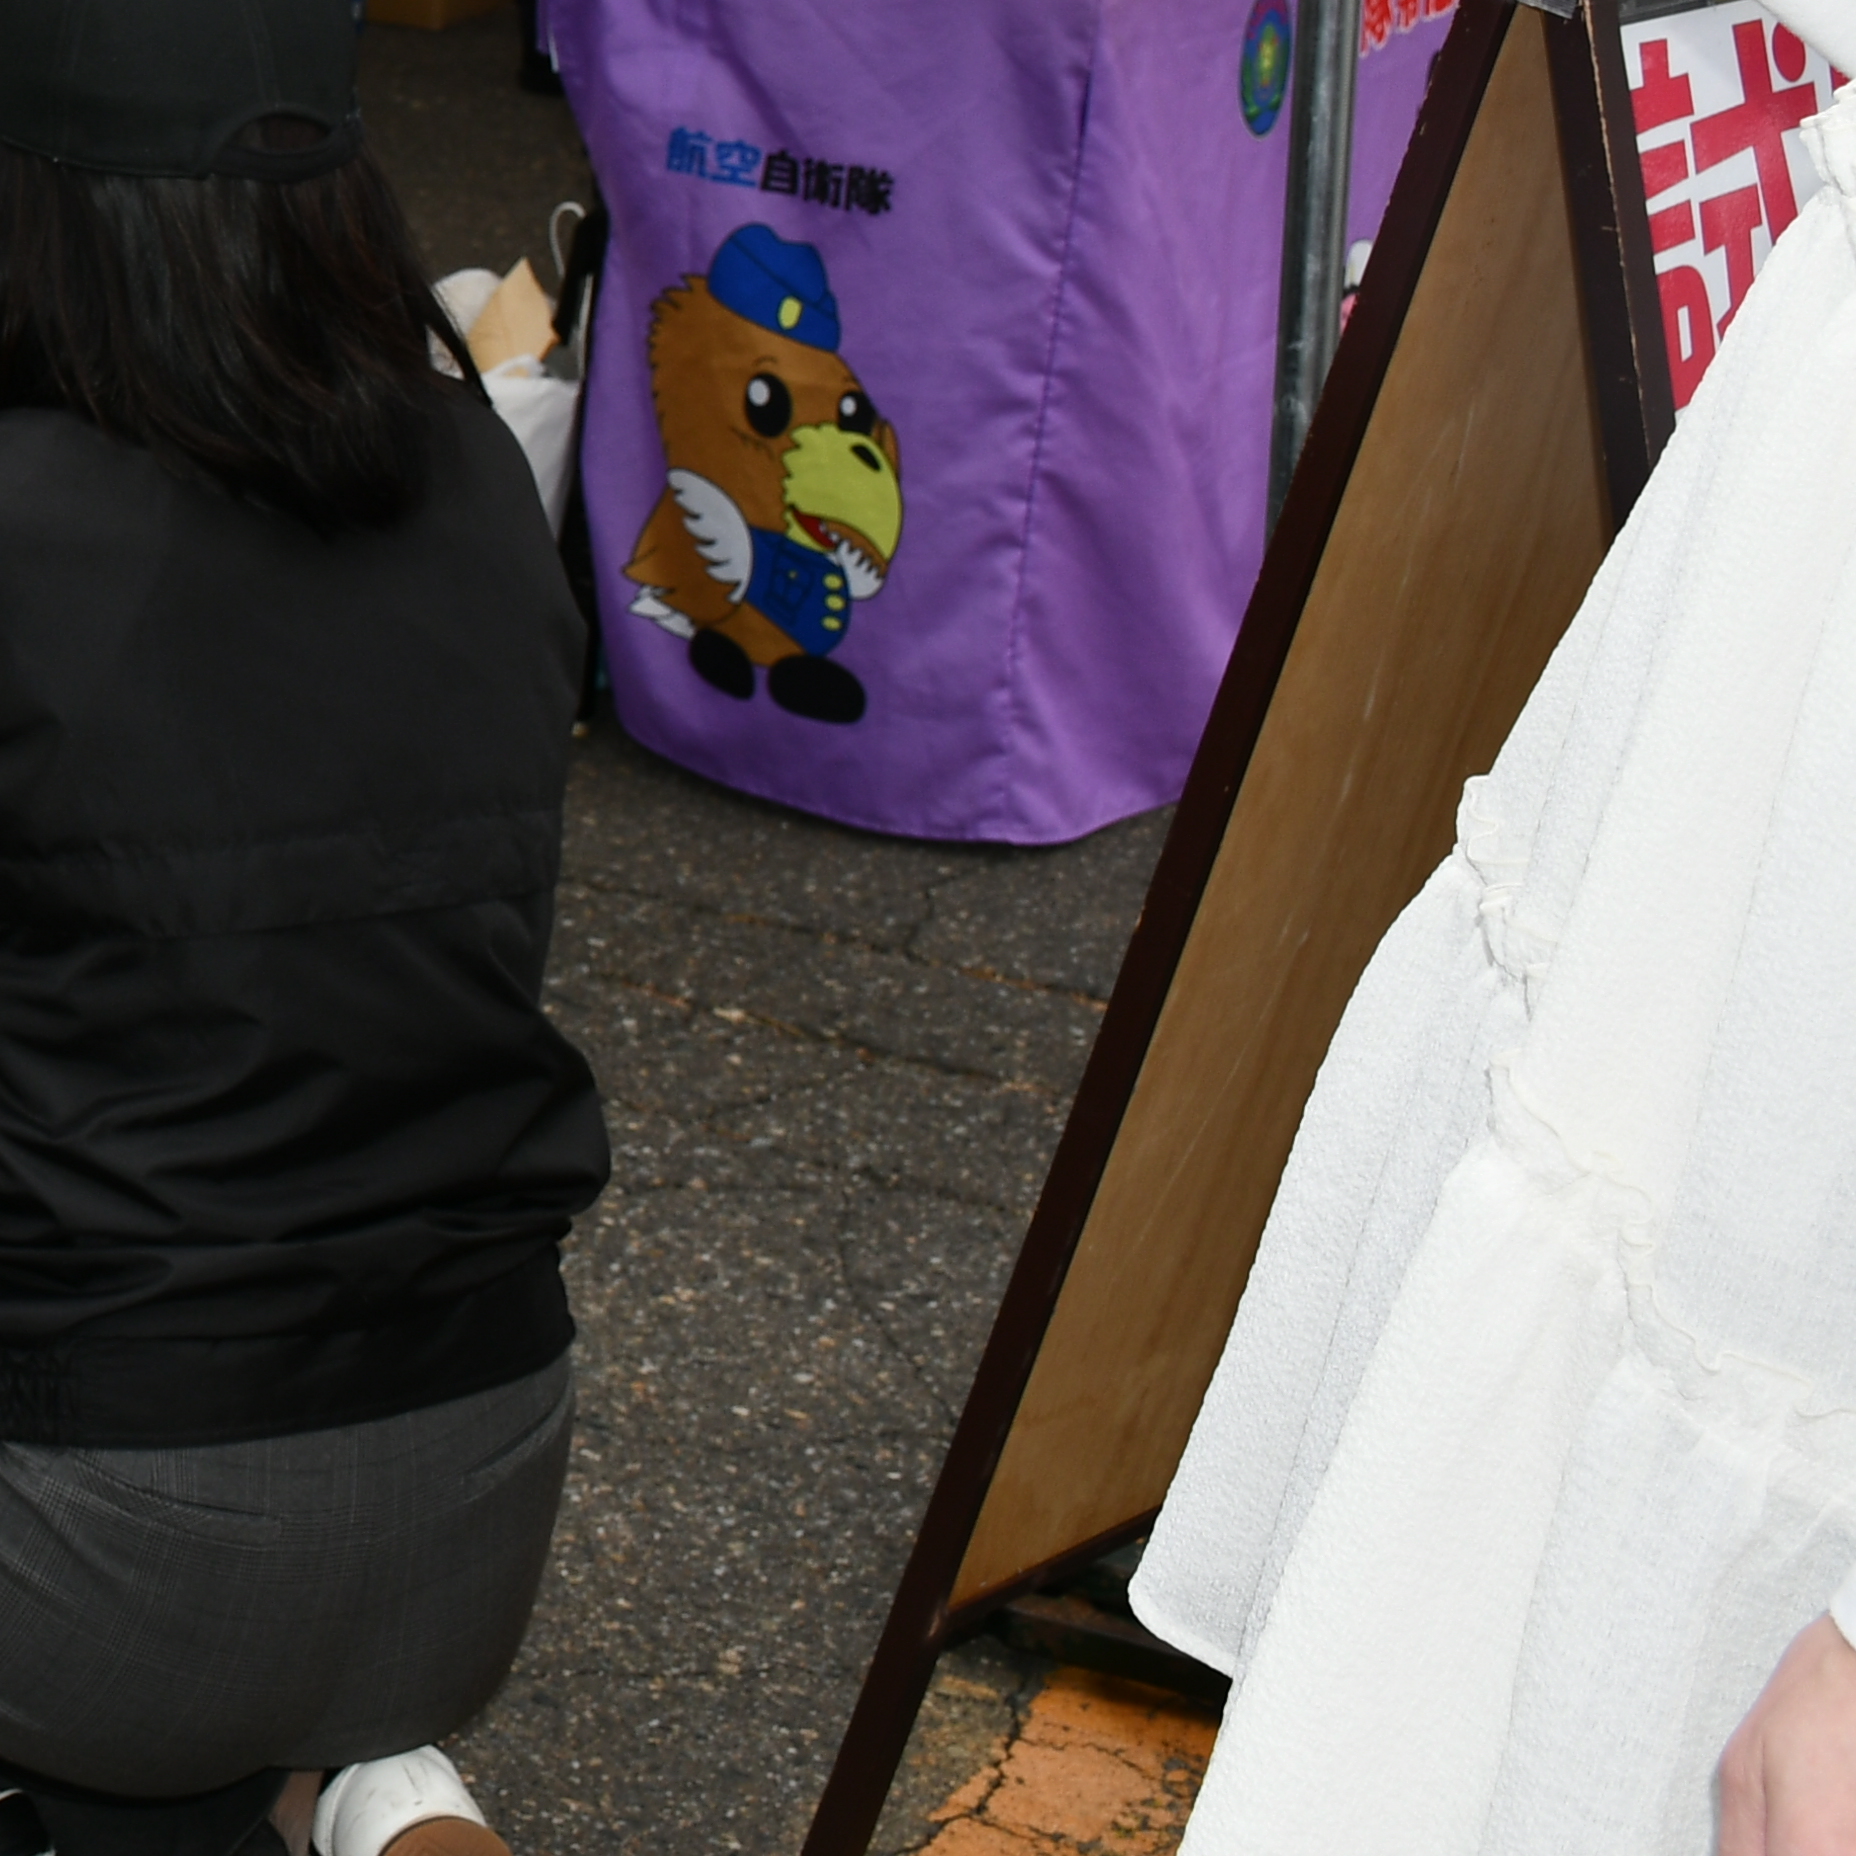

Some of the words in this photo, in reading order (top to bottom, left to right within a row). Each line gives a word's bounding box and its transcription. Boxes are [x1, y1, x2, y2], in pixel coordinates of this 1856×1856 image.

[666, 126, 895, 215] 航空自衛隊
[1630, 19, 1850, 412] 試
